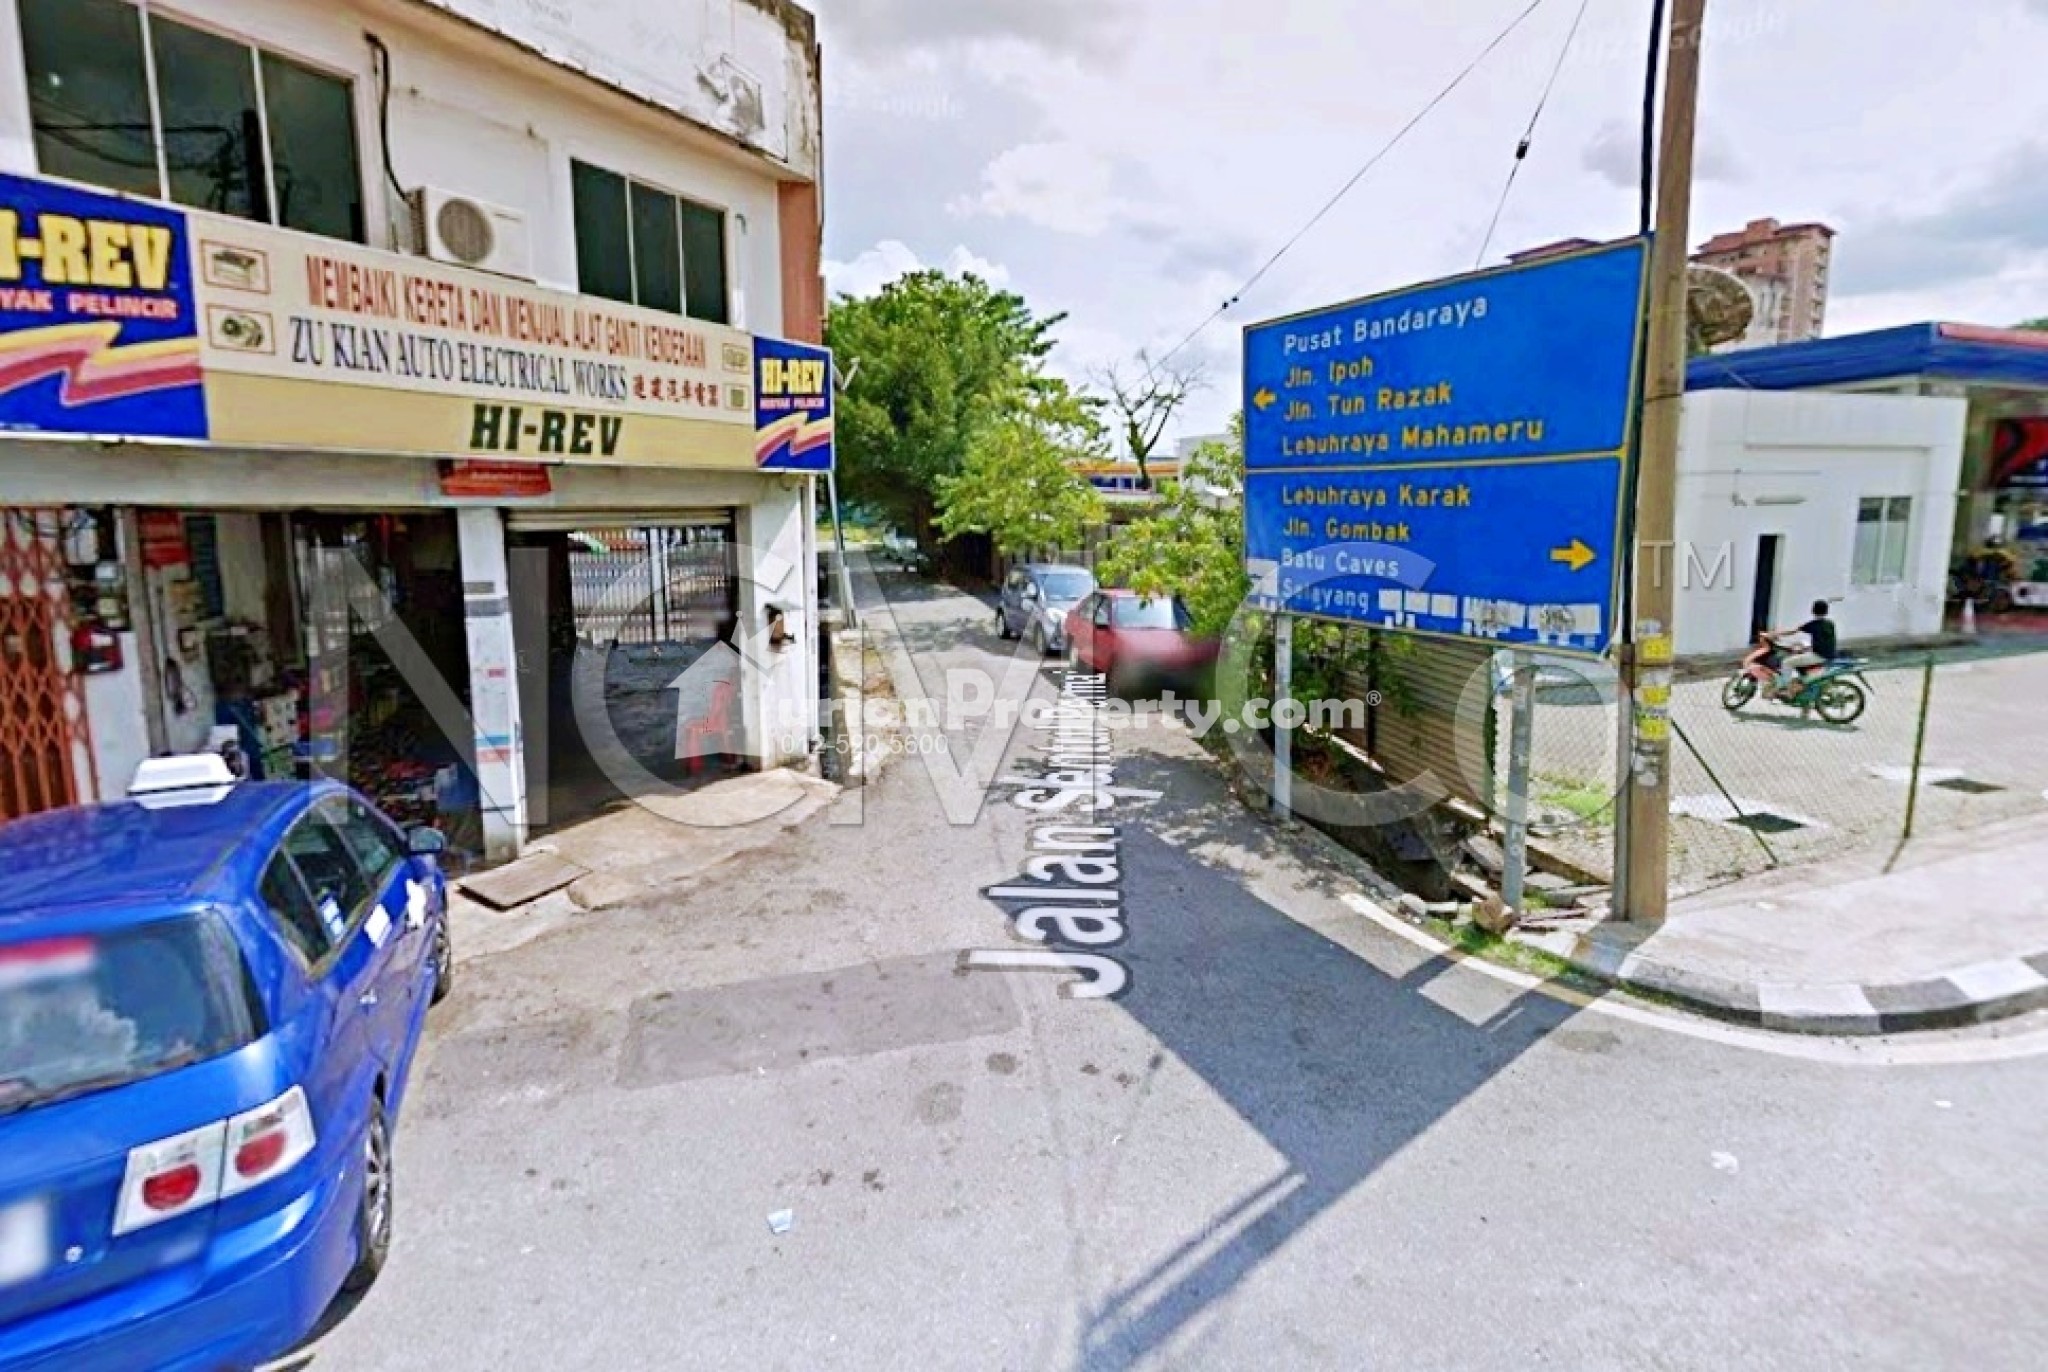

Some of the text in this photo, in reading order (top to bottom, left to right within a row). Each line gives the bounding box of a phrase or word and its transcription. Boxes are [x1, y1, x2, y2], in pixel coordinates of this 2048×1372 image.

[403, 275, 466, 332] KERETA
[470, 288, 503, 337] DAN
[1284, 296, 1488, 356] Pusat Bandaraya
[289, 316, 324, 366] ZU
[331, 323, 390, 374] KIAN
[397, 332, 452, 382] AUTO
[457, 342, 570, 394] ELECTRICAL
[572, 359, 627, 400] WORKS
[1284, 355, 1373, 390] Jln. Ipoh
[1284, 380, 1453, 423] Jln. Tun Razak
[470, 404, 622, 456] HI-REV
[1282, 418, 1544, 457] Lebuhraya Mahameru
[1282, 484, 1471, 509] Lebuhraya Karak
[1282, 516, 1410, 542] Jln. Gombak
[1281, 548, 1402, 577] Batu Caves
